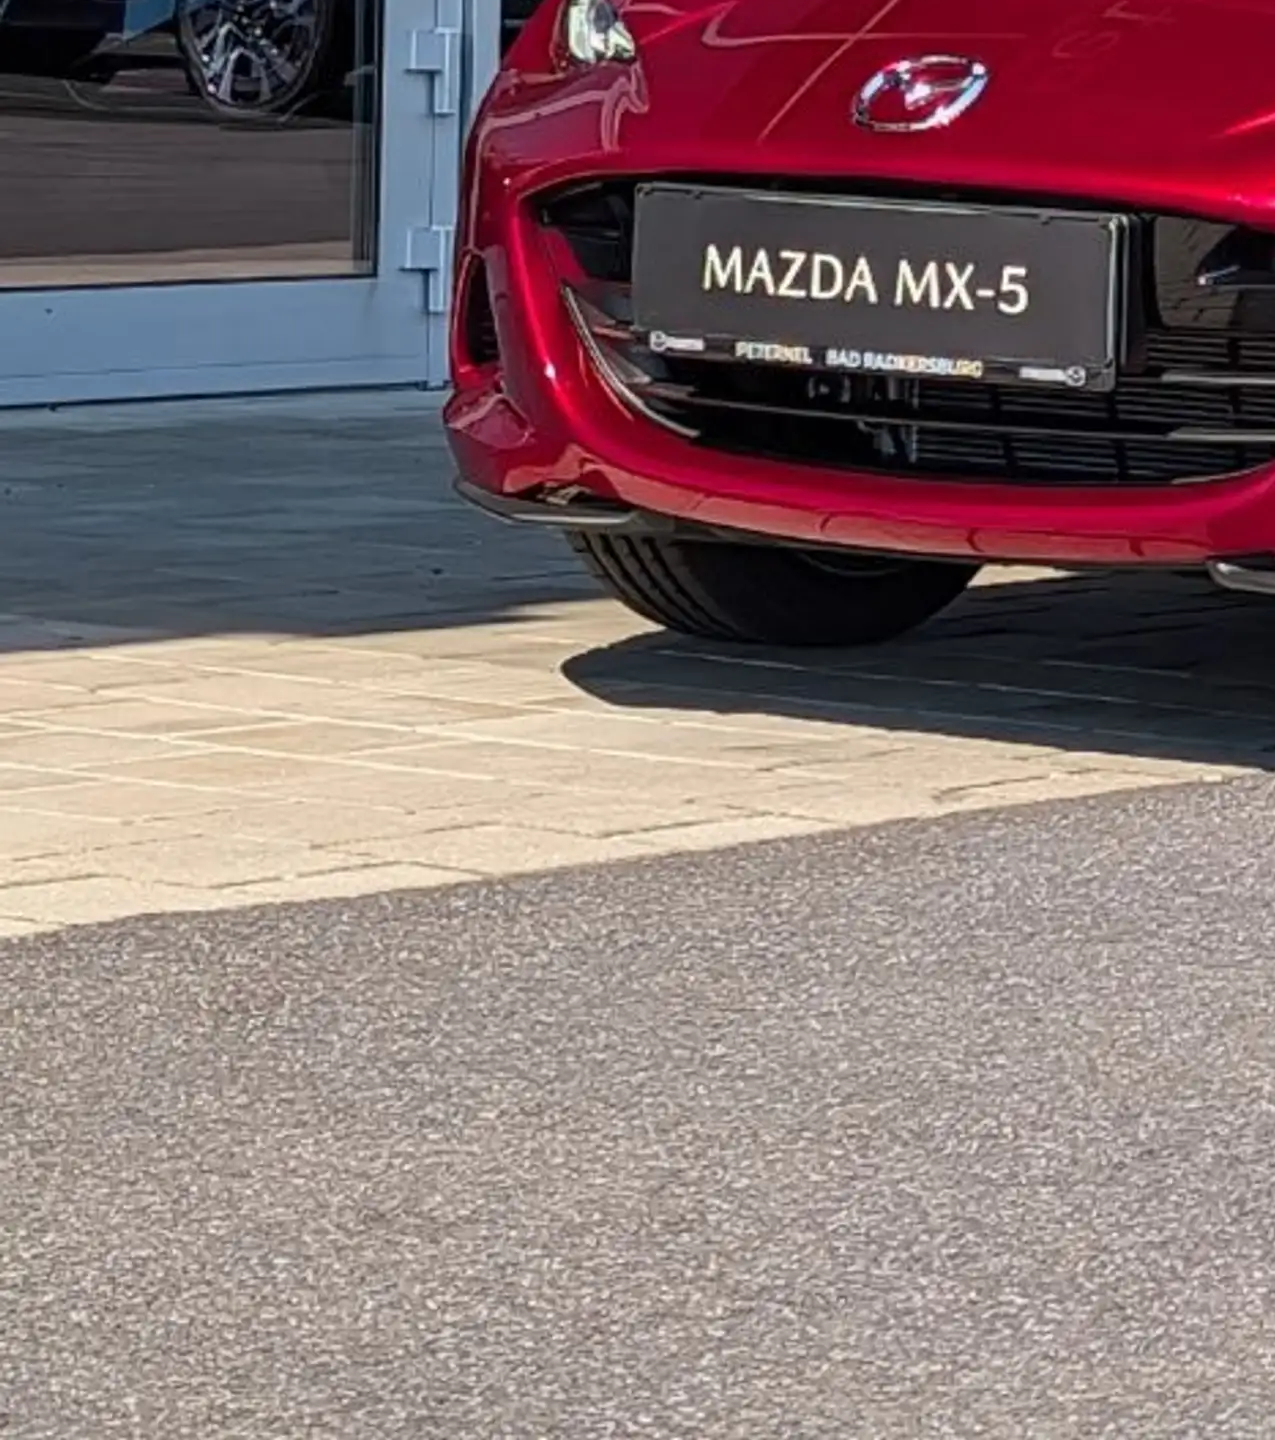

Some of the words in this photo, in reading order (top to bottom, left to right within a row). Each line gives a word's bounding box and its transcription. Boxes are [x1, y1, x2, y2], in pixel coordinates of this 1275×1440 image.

[702, 243, 878, 304] MAZDA
[894, 259, 1029, 315] MX-5
[826, 348, 861, 368] BAD
